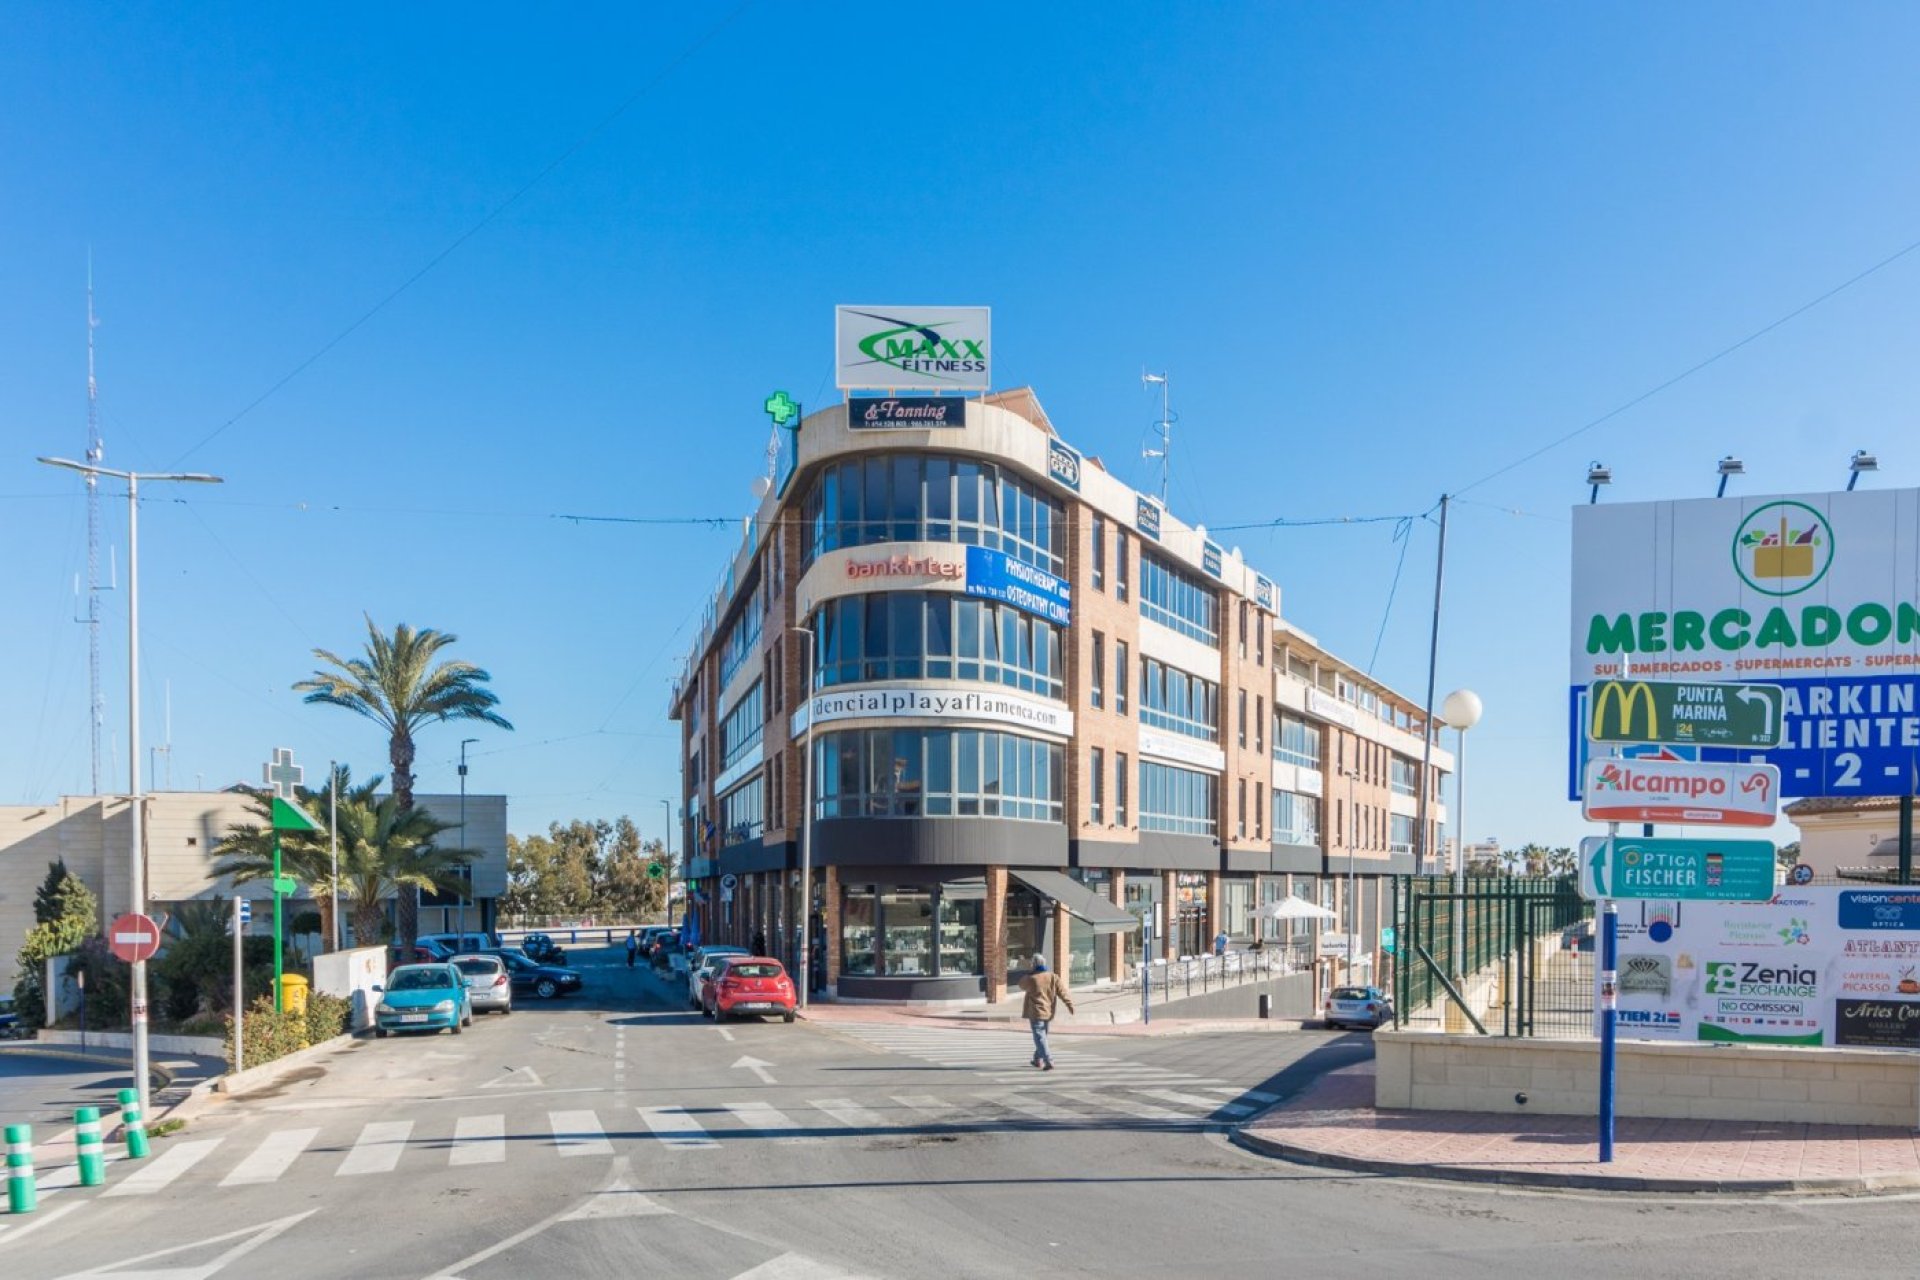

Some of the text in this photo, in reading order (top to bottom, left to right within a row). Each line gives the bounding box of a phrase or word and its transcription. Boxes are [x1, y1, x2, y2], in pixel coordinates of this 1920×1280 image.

[885, 337, 985, 359] MAXX
[902, 360, 986, 373] FITNESS
[880, 401, 947, 420] Tanning
[1594, 660, 1722, 675] SUPRMERCADOS
[1735, 656, 1851, 671] SUPERMERCATS
[1677, 686, 1724, 703] PUNTA
[1783, 684, 1914, 716] ARKIN
[1672, 704, 1727, 720] MARINA
[1779, 718, 1920, 749] LIENTE
[1833, 754, 1862, 786] 2
[1625, 869, 1696, 886] FISCHER
[1741, 962, 1816, 985] Zenia
[1740, 984, 1816, 998] EXCHANGE
[1843, 983, 1890, 992] PICASSO
[1721, 1001, 1799, 1013] NO COMISSION
[1619, 1011, 1650, 1022] TIEN
